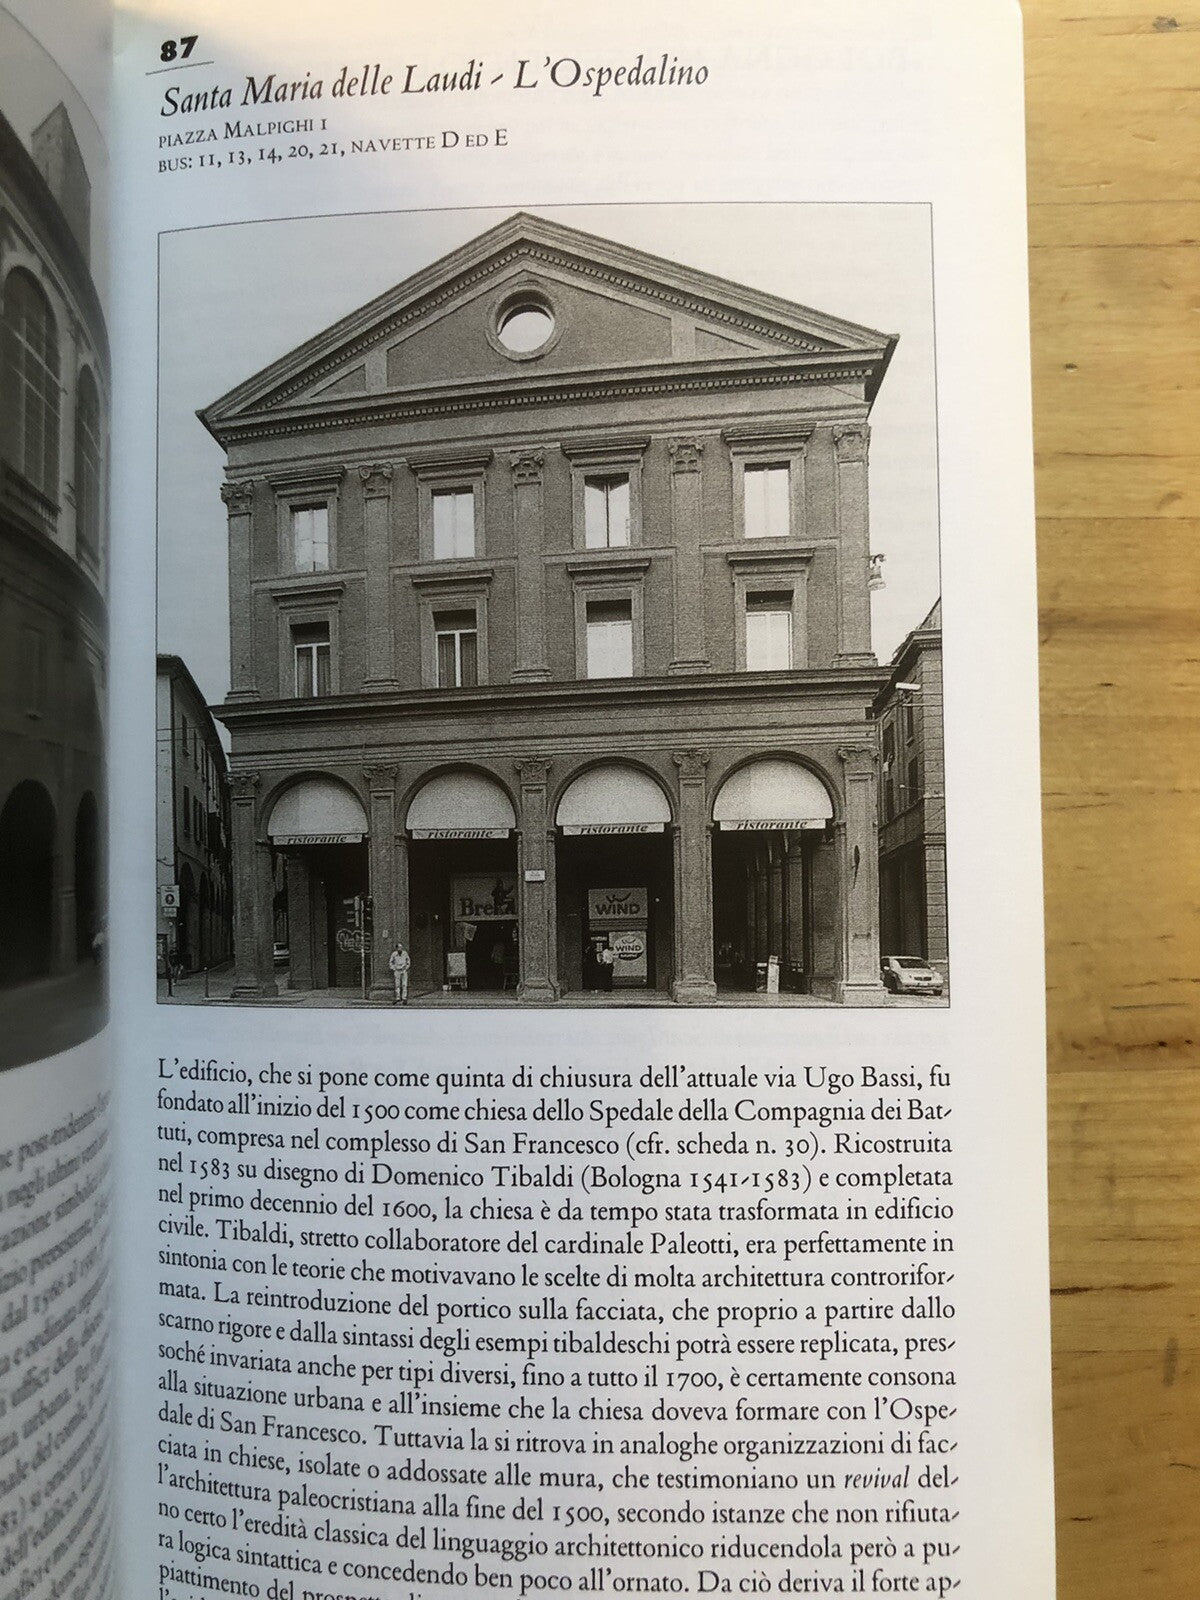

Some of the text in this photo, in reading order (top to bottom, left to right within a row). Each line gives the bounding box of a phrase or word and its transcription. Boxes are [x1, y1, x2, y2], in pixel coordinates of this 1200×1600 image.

[160, 35, 199, 63] 87
[160, 85, 232, 117] Santa
[240, 72, 323, 106] Maria
[332, 63, 393, 98] delle
[401, 59, 483, 94] Laudi
[513, 53, 709, 97] L'Ospedalino
[228, 150, 252, 166] 13,
[259, 147, 282, 164] 14,
[287, 144, 314, 159] 20,
[319, 142, 345, 157] 21,
[287, 835, 348, 845] ristorante
[428, 829, 493, 839] ristorante
[580, 823, 649, 835] ristorante
[737, 819, 808, 830] ristorante
[595, 903, 641, 915] WIND
[615, 944, 641, 952] WIND
[158, 1057, 951, 1095] L'edificio, che si pone come quinta di chiusura dell'attuale via Ugo Bassi, fu
[157, 1087, 224, 1113] fondato
[227, 1092, 312, 1117] all'inizio
[316, 1095, 346, 1118] del
[352, 1104, 400, 1124] 1500
[404, 1105, 460, 1120] come
[464, 1097, 528, 1121] chiesa
[532, 1097, 584, 1121] dello
[589, 1098, 673, 1129] Spedale
[678, 1098, 729, 1121] della
[734, 1098, 866, 1128] Compagnia
[871, 1097, 902, 1120] dei
[158, 1151, 953, 1195] nel 1583 su disegno di Domenico Tibaldi (Bologna 1541-1583) e completata
[158, 1213, 954, 1262] civile. Tibaldi, stretto collaboratore del cardinale Paleotti, era perfettamente in
[158, 1244, 228, 1271] sintonia
[232, 1258, 267, 1275] con
[271, 1253, 288, 1276] le
[292, 1258, 346, 1280] teorie
[350, 1259, 385, 1282] che
[391, 1262, 516, 1286] motivavano
[521, 1263, 539, 1287] le
[544, 1264, 601, 1287] scelte
[606, 1264, 628, 1287] di
[634, 1264, 696, 1288] molta
[702, 1264, 825, 1288] architettura
[159, 1313, 214, 1333] scarno
[218, 1314, 272, 1343] rigore
[275, 1326, 285, 1340] e
[289, 1319, 338, 1344] dalla
[342, 1324, 414, 1349] sintassi
[419, 1326, 470, 1357] degli
[475, 1330, 548, 1360] esempi
[553, 1330, 670, 1354] tibaldeschi
[675, 1333, 732, 1362] potrà
[737, 1339, 795, 1354] essere
[800, 1330, 898, 1361] replicata,
[158, 1369, 188, 1394] alla
[194, 1375, 287, 1405] situazione
[294, 1385, 365, 1412] urbana
[372, 1398, 382, 1413] e
[388, 1391, 501, 1418] all'insieme
[508, 1396, 545, 1420] che
[552, 1396, 571, 1420] la
[578, 1397, 644, 1421] chiesa
[651, 1397, 728, 1421] doveva
[735, 1397, 819, 1421] formare
[827, 1406, 867, 1420] con
[158, 1400, 193, 1426] dale
[197, 1406, 215, 1430] di
[220, 1410, 257, 1435] San
[262, 1415, 367, 1445] Francesco.
[374, 1424, 465, 1450] Tuttavia
[470, 1427, 489, 1451] la
[494, 1429, 510, 1452] si
[516, 1430, 587, 1454] ritrova
[592, 1431, 614, 1454] in
[620, 1431, 718, 1462] analoghe
[723, 1431, 884, 1463] organizzazioni
[890, 1430, 912, 1454] di
[158, 1462, 272, 1503] l'architettura
[277, 1483, 416, 1516] paleocristiana
[422, 1493, 460, 1518] alla
[466, 1494, 506, 1520] fine
[512, 1496, 544, 1521] del
[553, 1506, 610, 1528] 1500,
[617, 1499, 705, 1524] secondo
[712, 1500, 785, 1524] istanze
[792, 1499, 829, 1524] che
[836, 1508, 879, 1524] non
[158, 1533, 174, 1550] ra
[178, 1529, 231, 1563] logica
[236, 1543, 323, 1574] sintattica
[328, 1561, 337, 1575] e
[343, 1559, 468, 1586] concedendo
[474, 1562, 513, 1588] ben
[519, 1573, 572, 1597] poco
[578, 1567, 689, 1593] all'ornato.
[697, 1570, 732, 1593] Da
[739, 1570, 771, 1593] ciò
[778, 1568, 845, 1593] deriva
[851, 1568, 865, 1592] il
[872, 1568, 919, 1592] forte
[159, 1560, 260, 1598] piattimento
[266, 1578, 294, 1600] del
